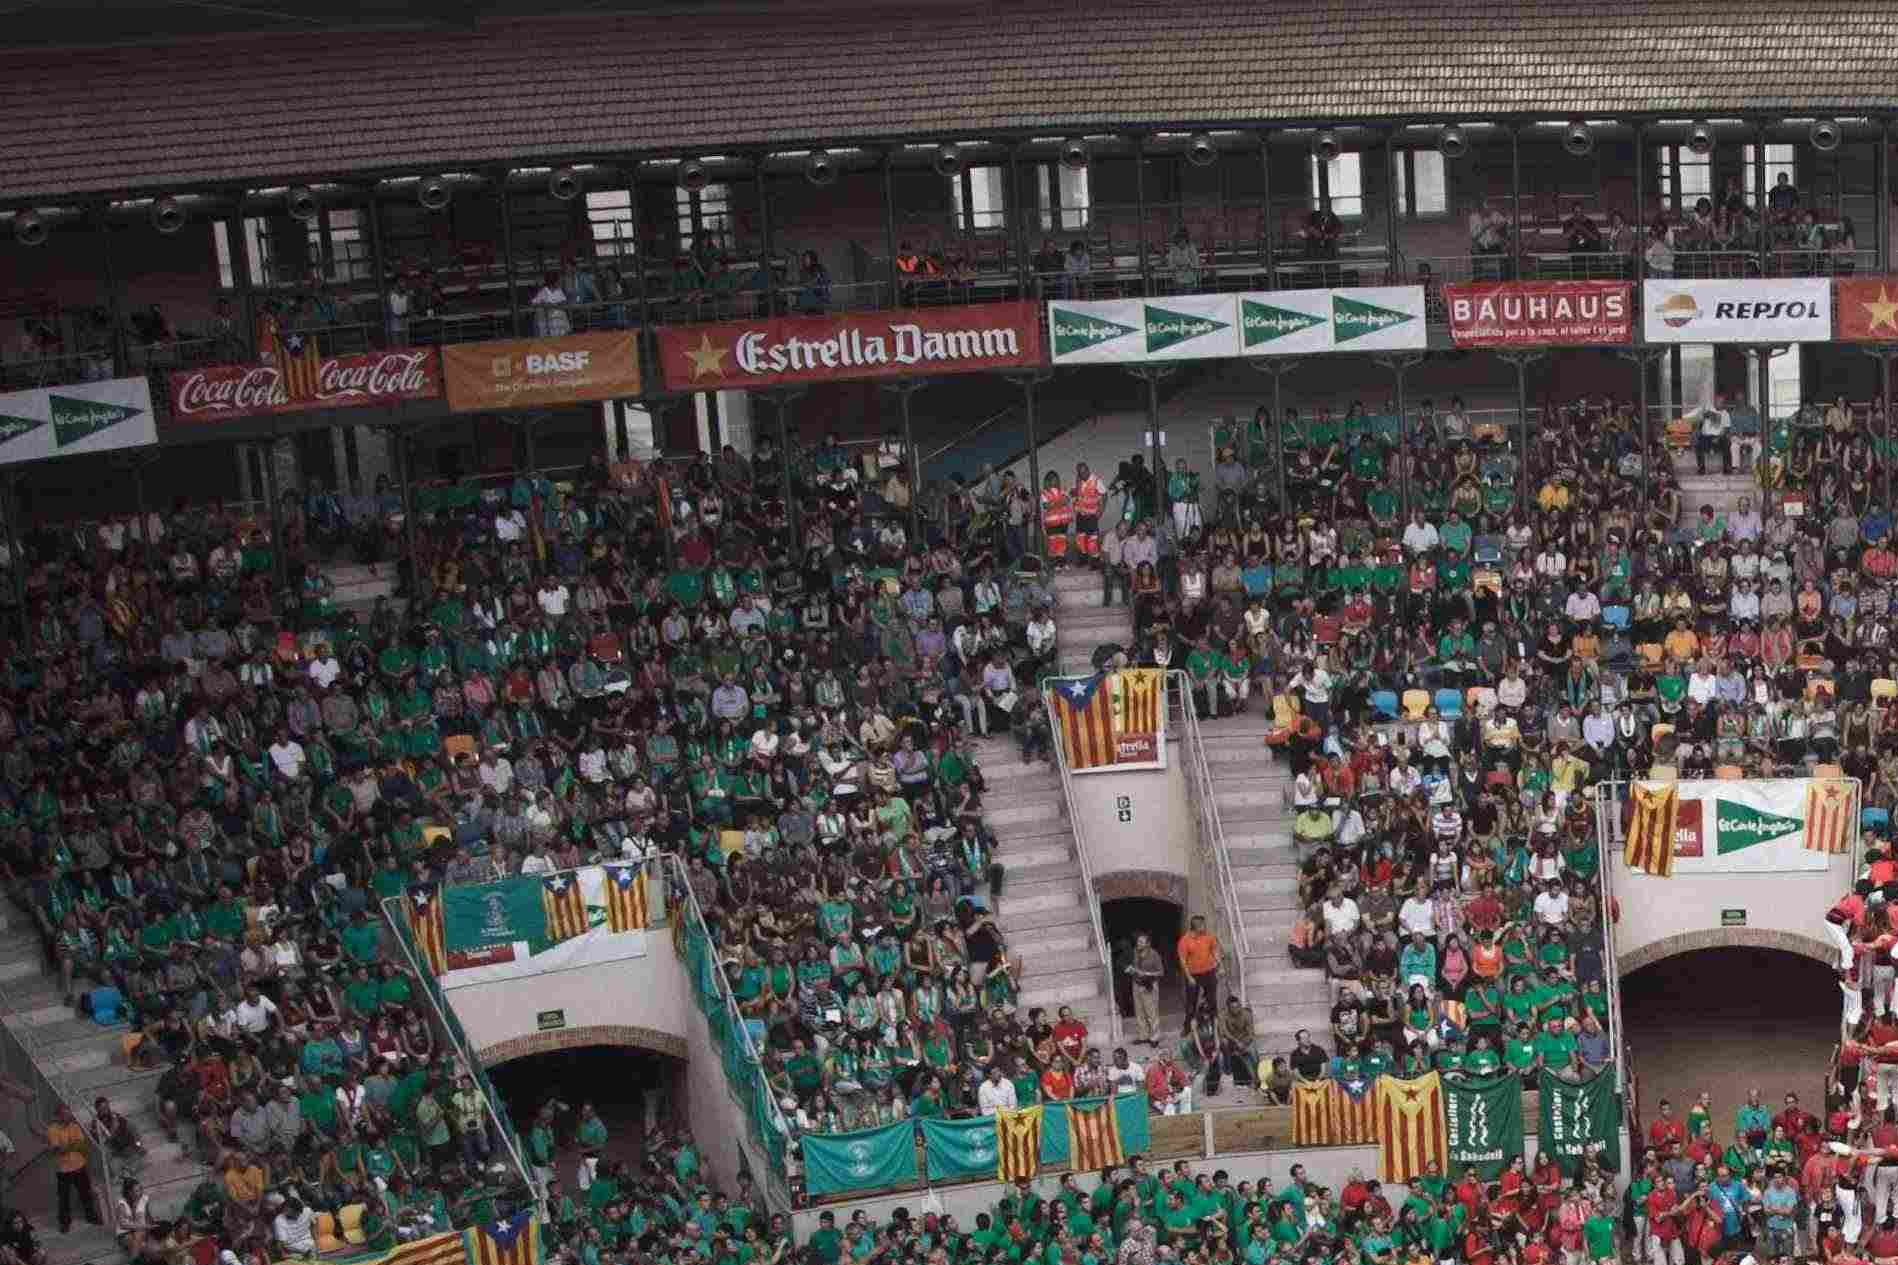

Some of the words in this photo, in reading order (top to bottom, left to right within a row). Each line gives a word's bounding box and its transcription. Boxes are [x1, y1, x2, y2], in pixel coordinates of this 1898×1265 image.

[1453, 295, 1624, 321] BAUHAUS
[1715, 301, 1820, 319] REPSOL
[735, 328, 888, 375] Estrella
[888, 323, 1020, 365] Damm
[526, 350, 592, 375] BASF
[1718, 817, 1729, 832] El
[1730, 819, 1757, 832] Corte
[1757, 815, 1796, 836] Inglés
